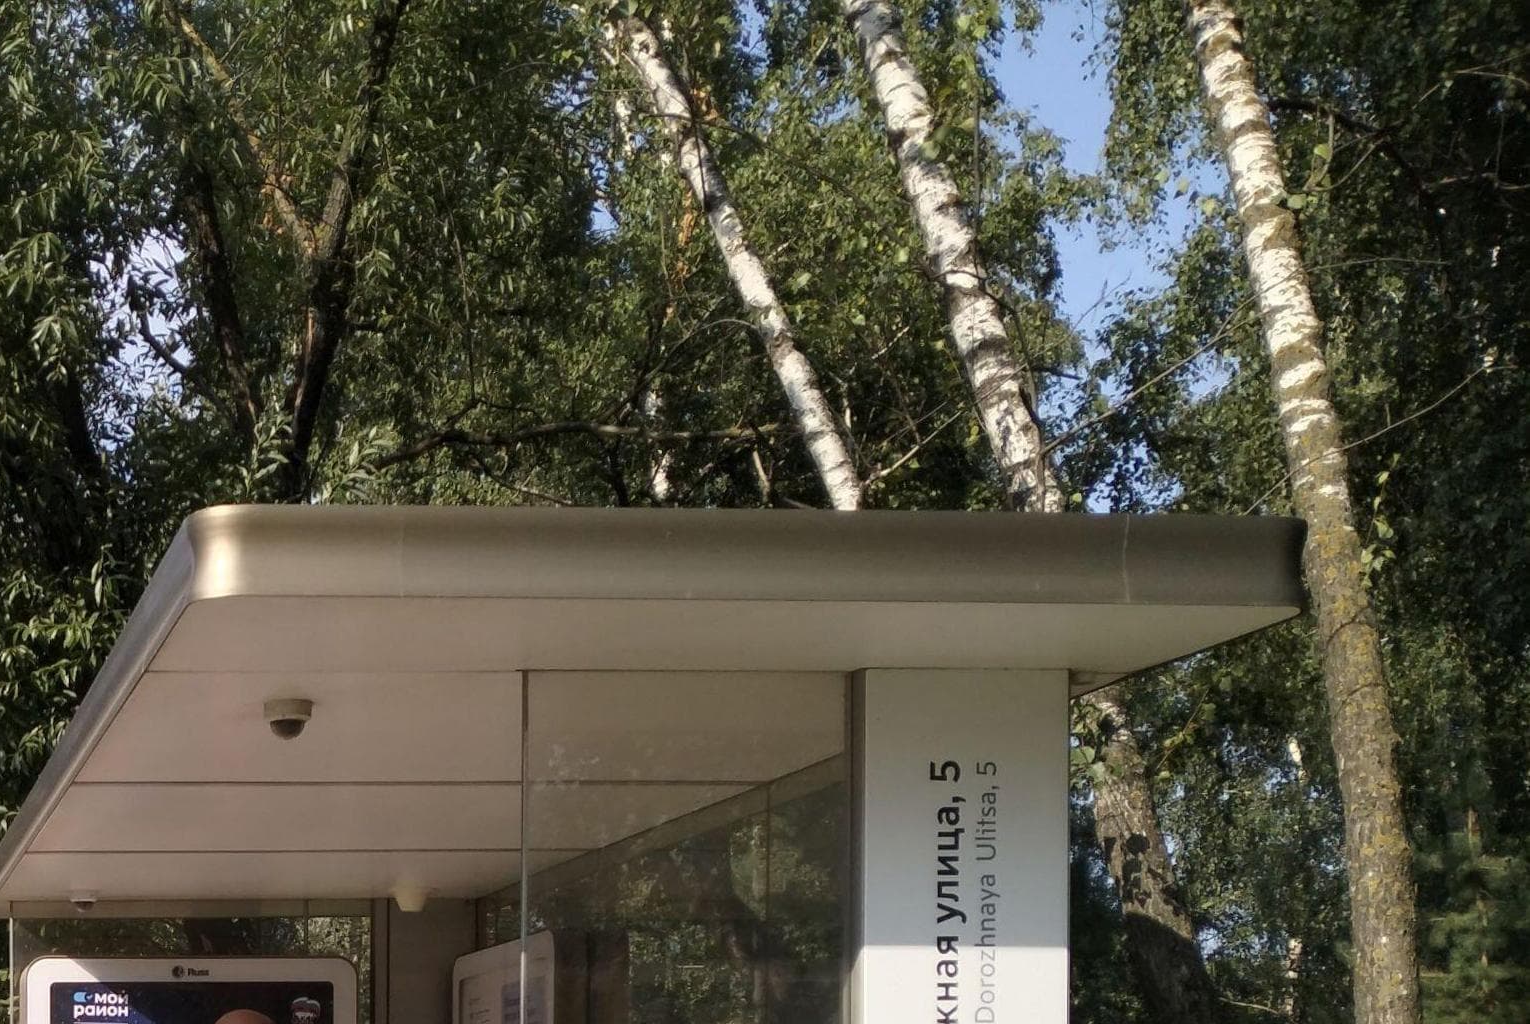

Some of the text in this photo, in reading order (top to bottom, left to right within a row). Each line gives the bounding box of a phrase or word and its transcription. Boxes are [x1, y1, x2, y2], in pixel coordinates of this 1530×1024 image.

[930, 759, 961, 783] 5
[936, 790, 967, 925] улица,
[975, 760, 1001, 1024] Dorozhnaya Ulitsa, 5
